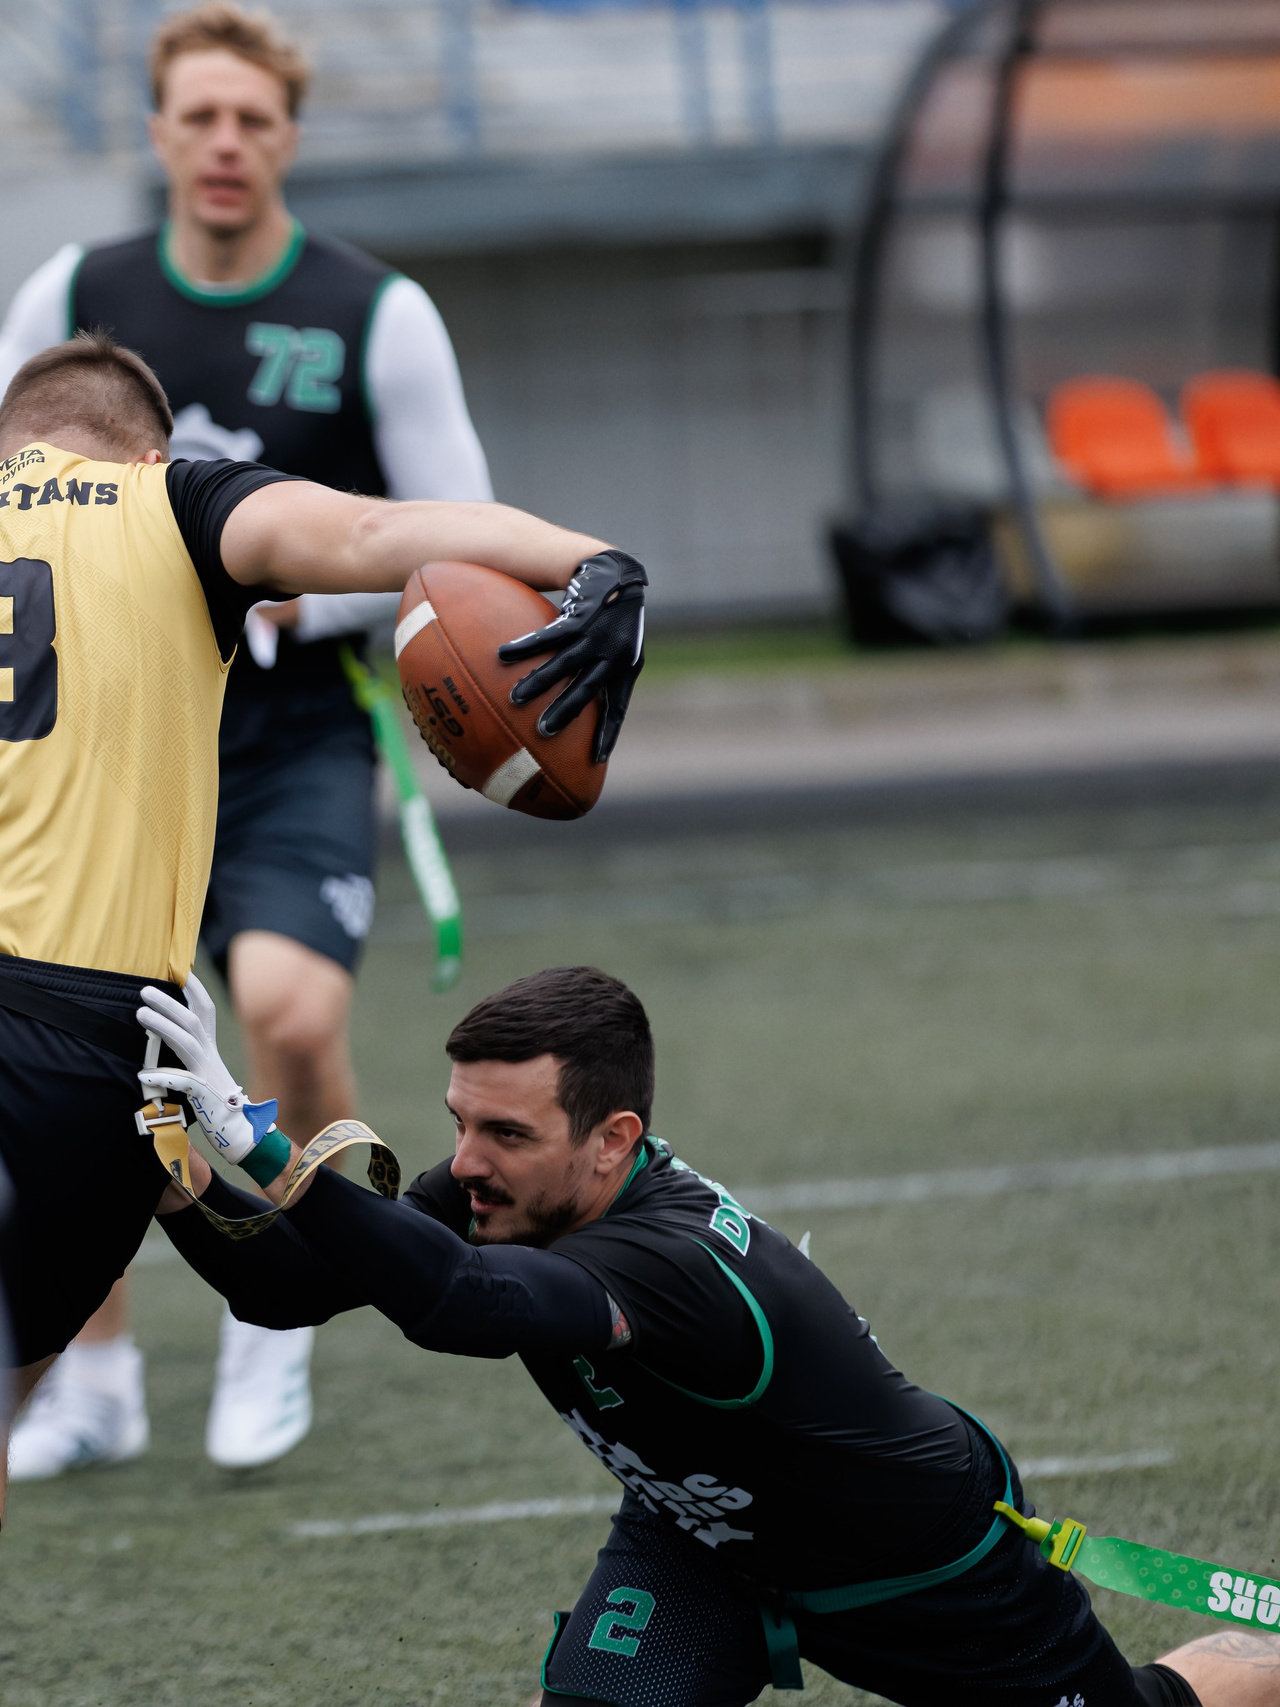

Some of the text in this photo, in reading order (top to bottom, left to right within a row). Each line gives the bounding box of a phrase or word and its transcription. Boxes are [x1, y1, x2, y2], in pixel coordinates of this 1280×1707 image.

[244, 321, 346, 414] 72
[420, 682, 464, 738] GST
[588, 1586, 656, 1657] 2
[1207, 1571, 1280, 1628] ORS
